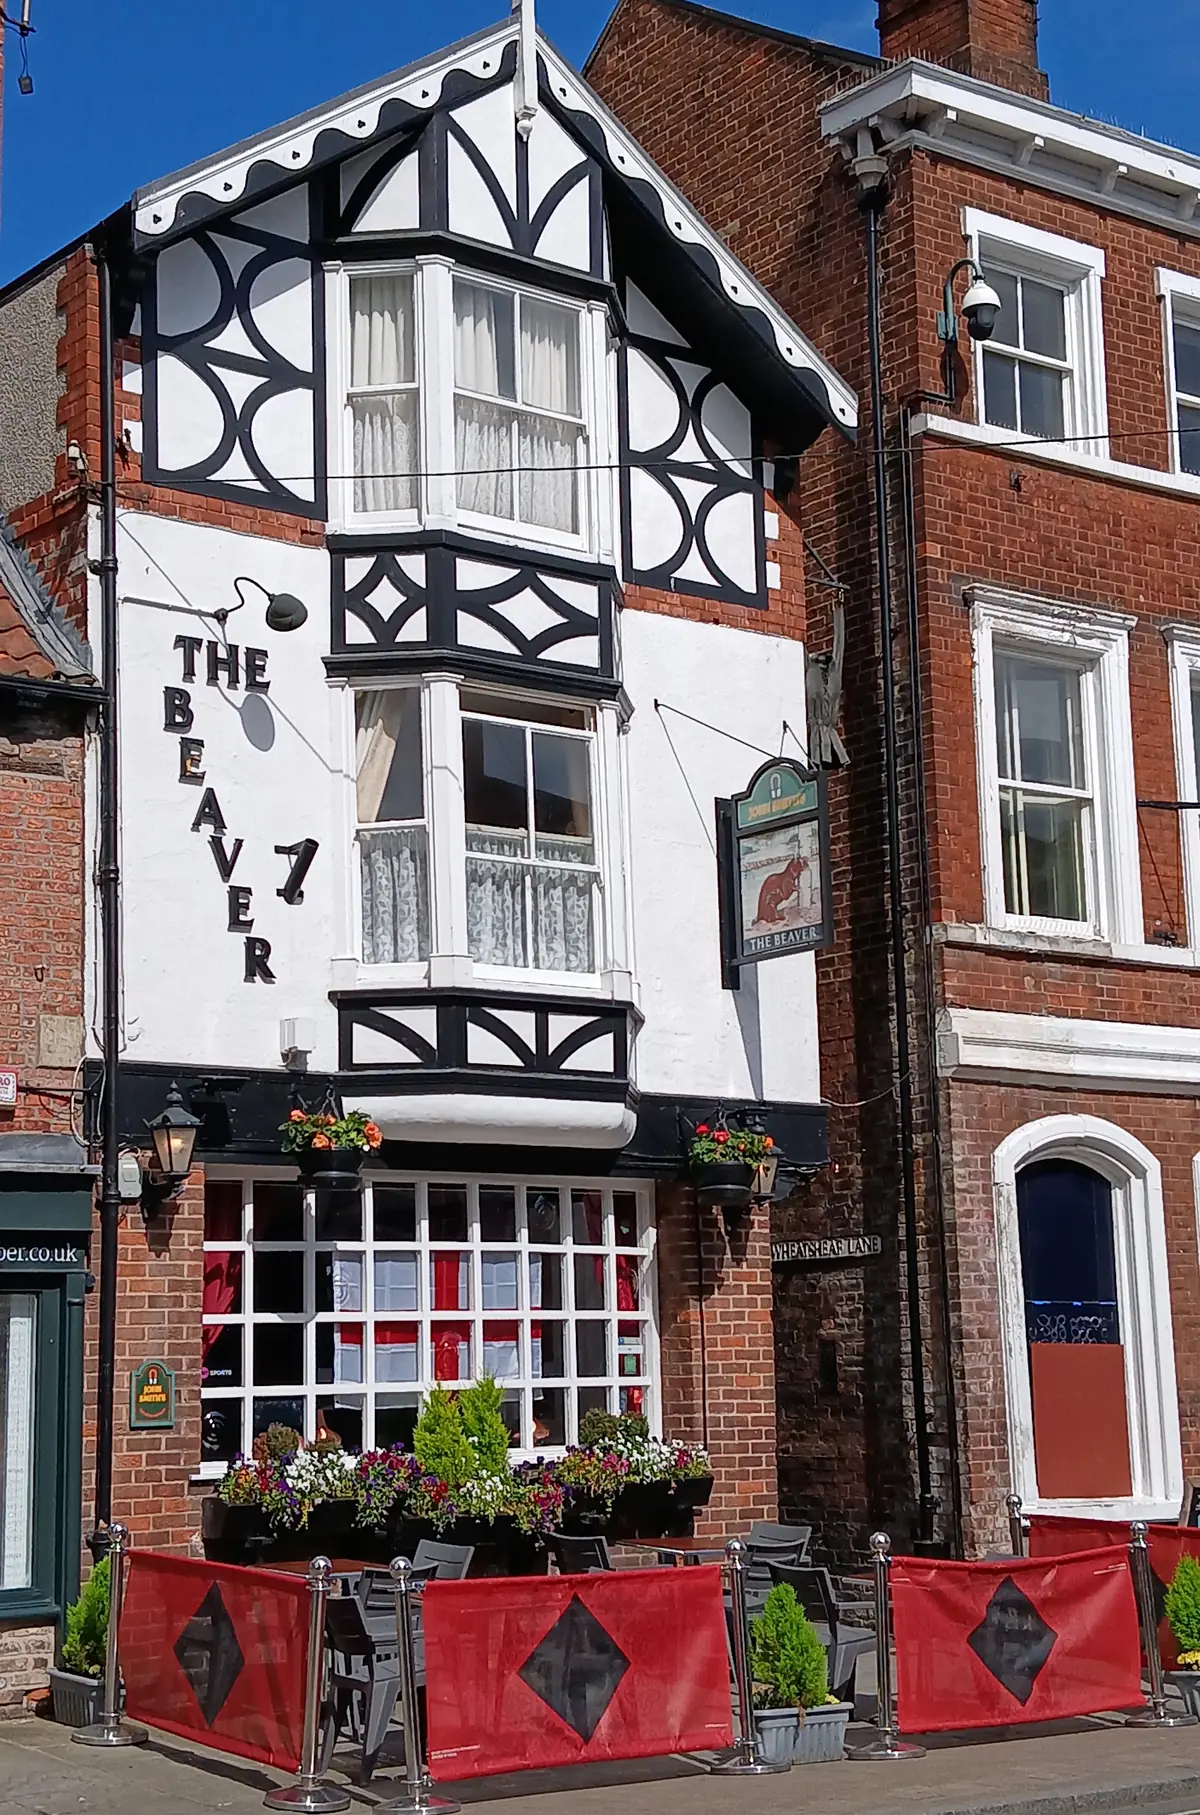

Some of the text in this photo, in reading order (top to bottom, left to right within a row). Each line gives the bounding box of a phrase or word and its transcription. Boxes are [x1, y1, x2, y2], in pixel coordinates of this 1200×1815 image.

[173, 634, 270, 694] THE
[163, 686, 276, 984] BEAVER
[750, 927, 817, 951] THE BEAVER
[848, 1236, 879, 1254] LANE
